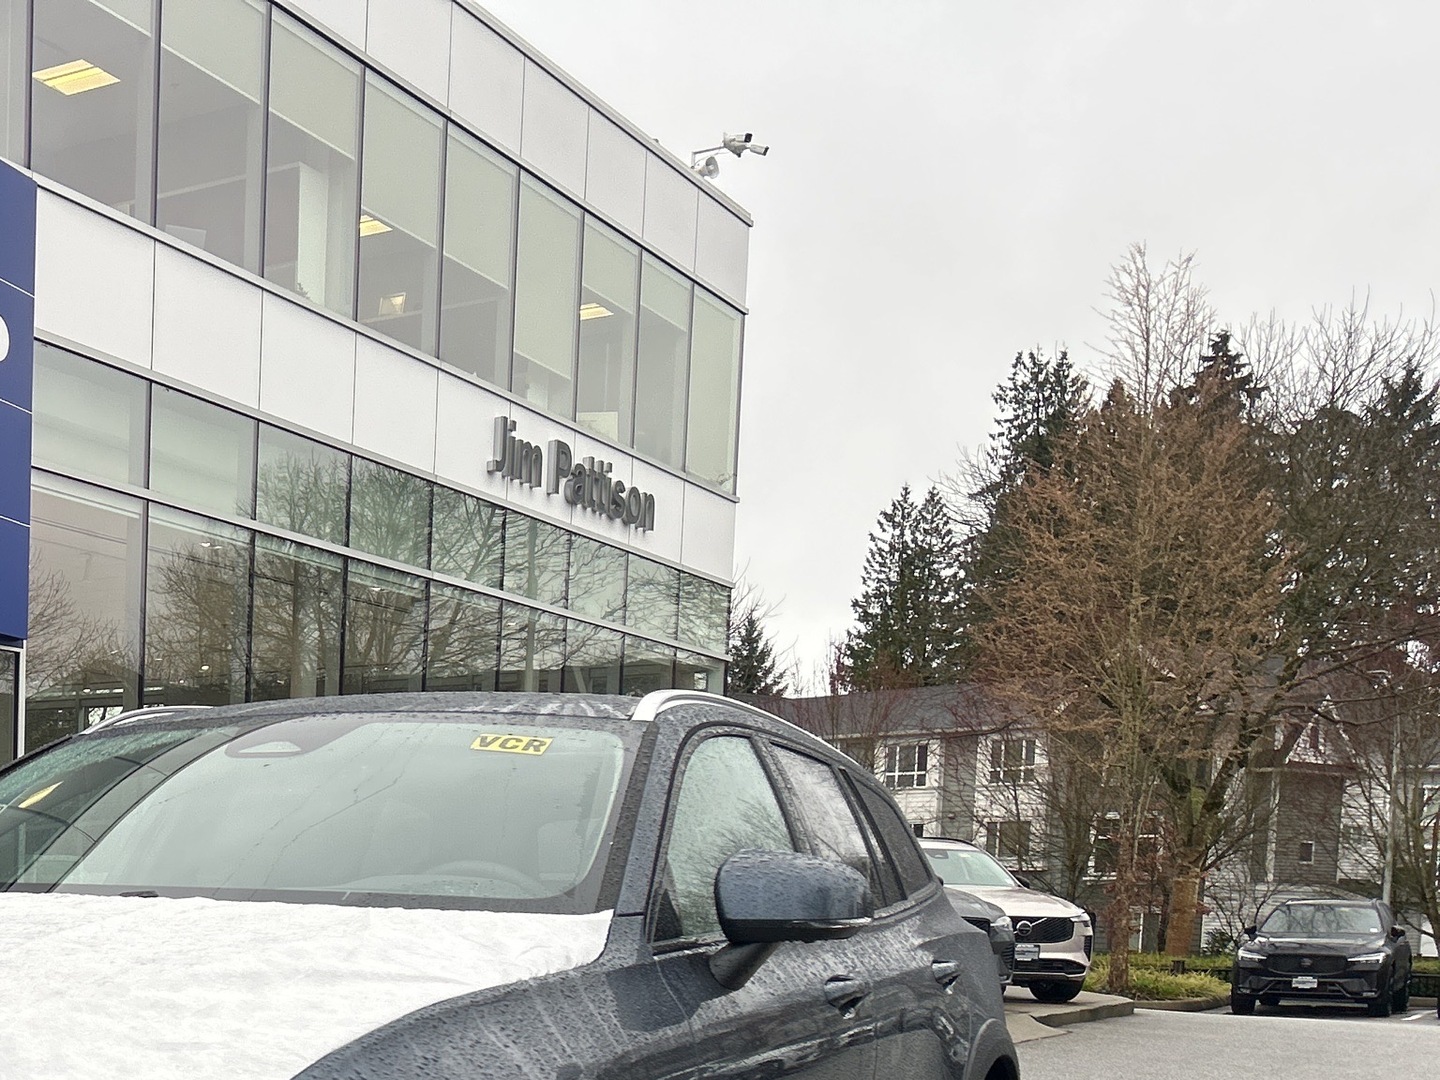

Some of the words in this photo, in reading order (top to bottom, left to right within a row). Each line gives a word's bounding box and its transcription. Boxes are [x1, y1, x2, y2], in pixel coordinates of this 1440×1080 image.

[487, 415, 543, 489] Jim
[546, 439, 656, 532] Pattison
[479, 735, 547, 753] VCR
